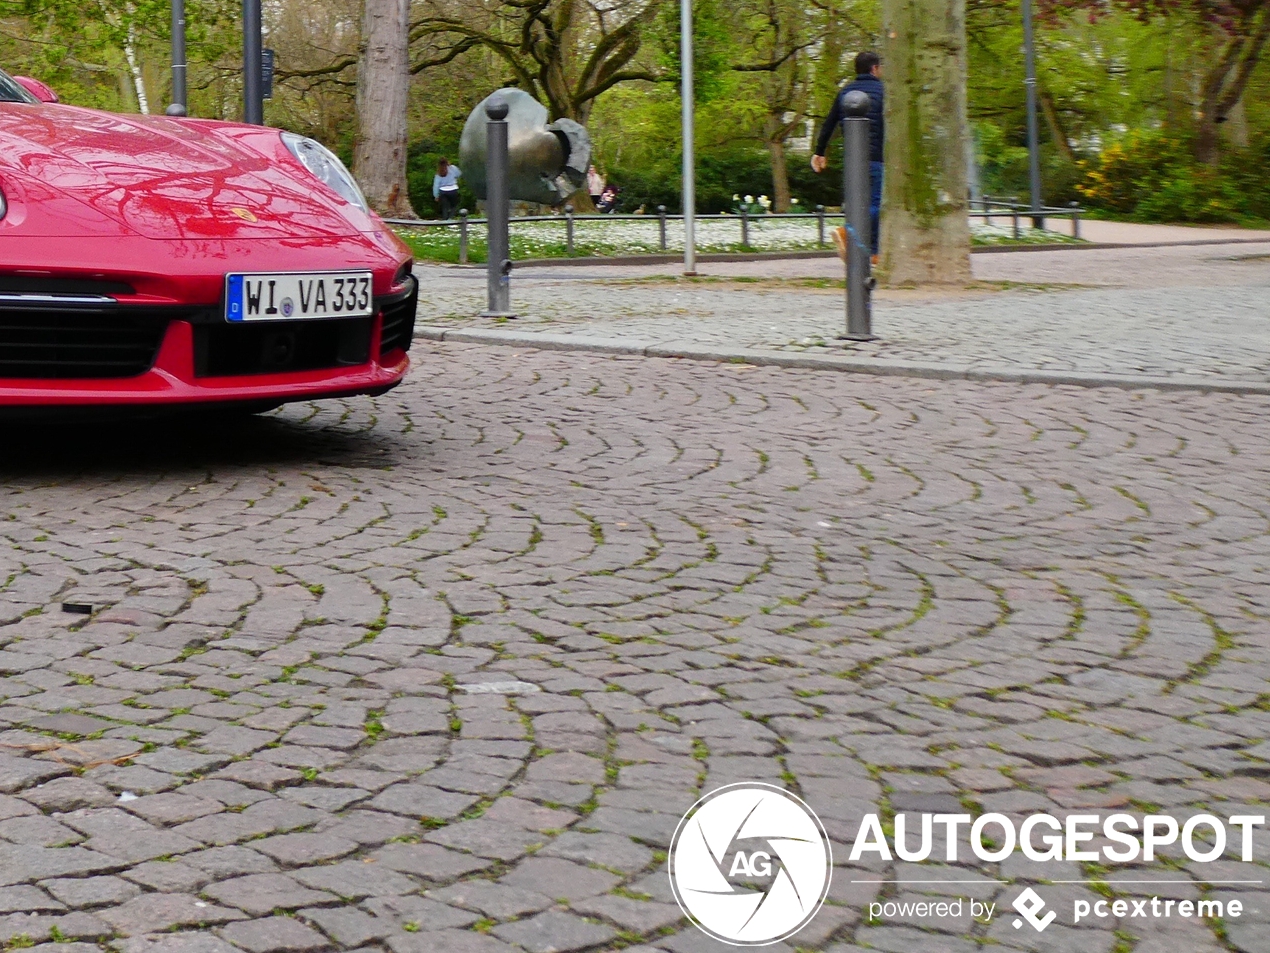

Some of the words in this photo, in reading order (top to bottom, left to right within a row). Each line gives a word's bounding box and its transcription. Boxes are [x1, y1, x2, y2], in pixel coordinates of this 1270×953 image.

[245, 280, 278, 315] WI
[298, 279, 327, 313] VA
[332, 278, 369, 312] 333
